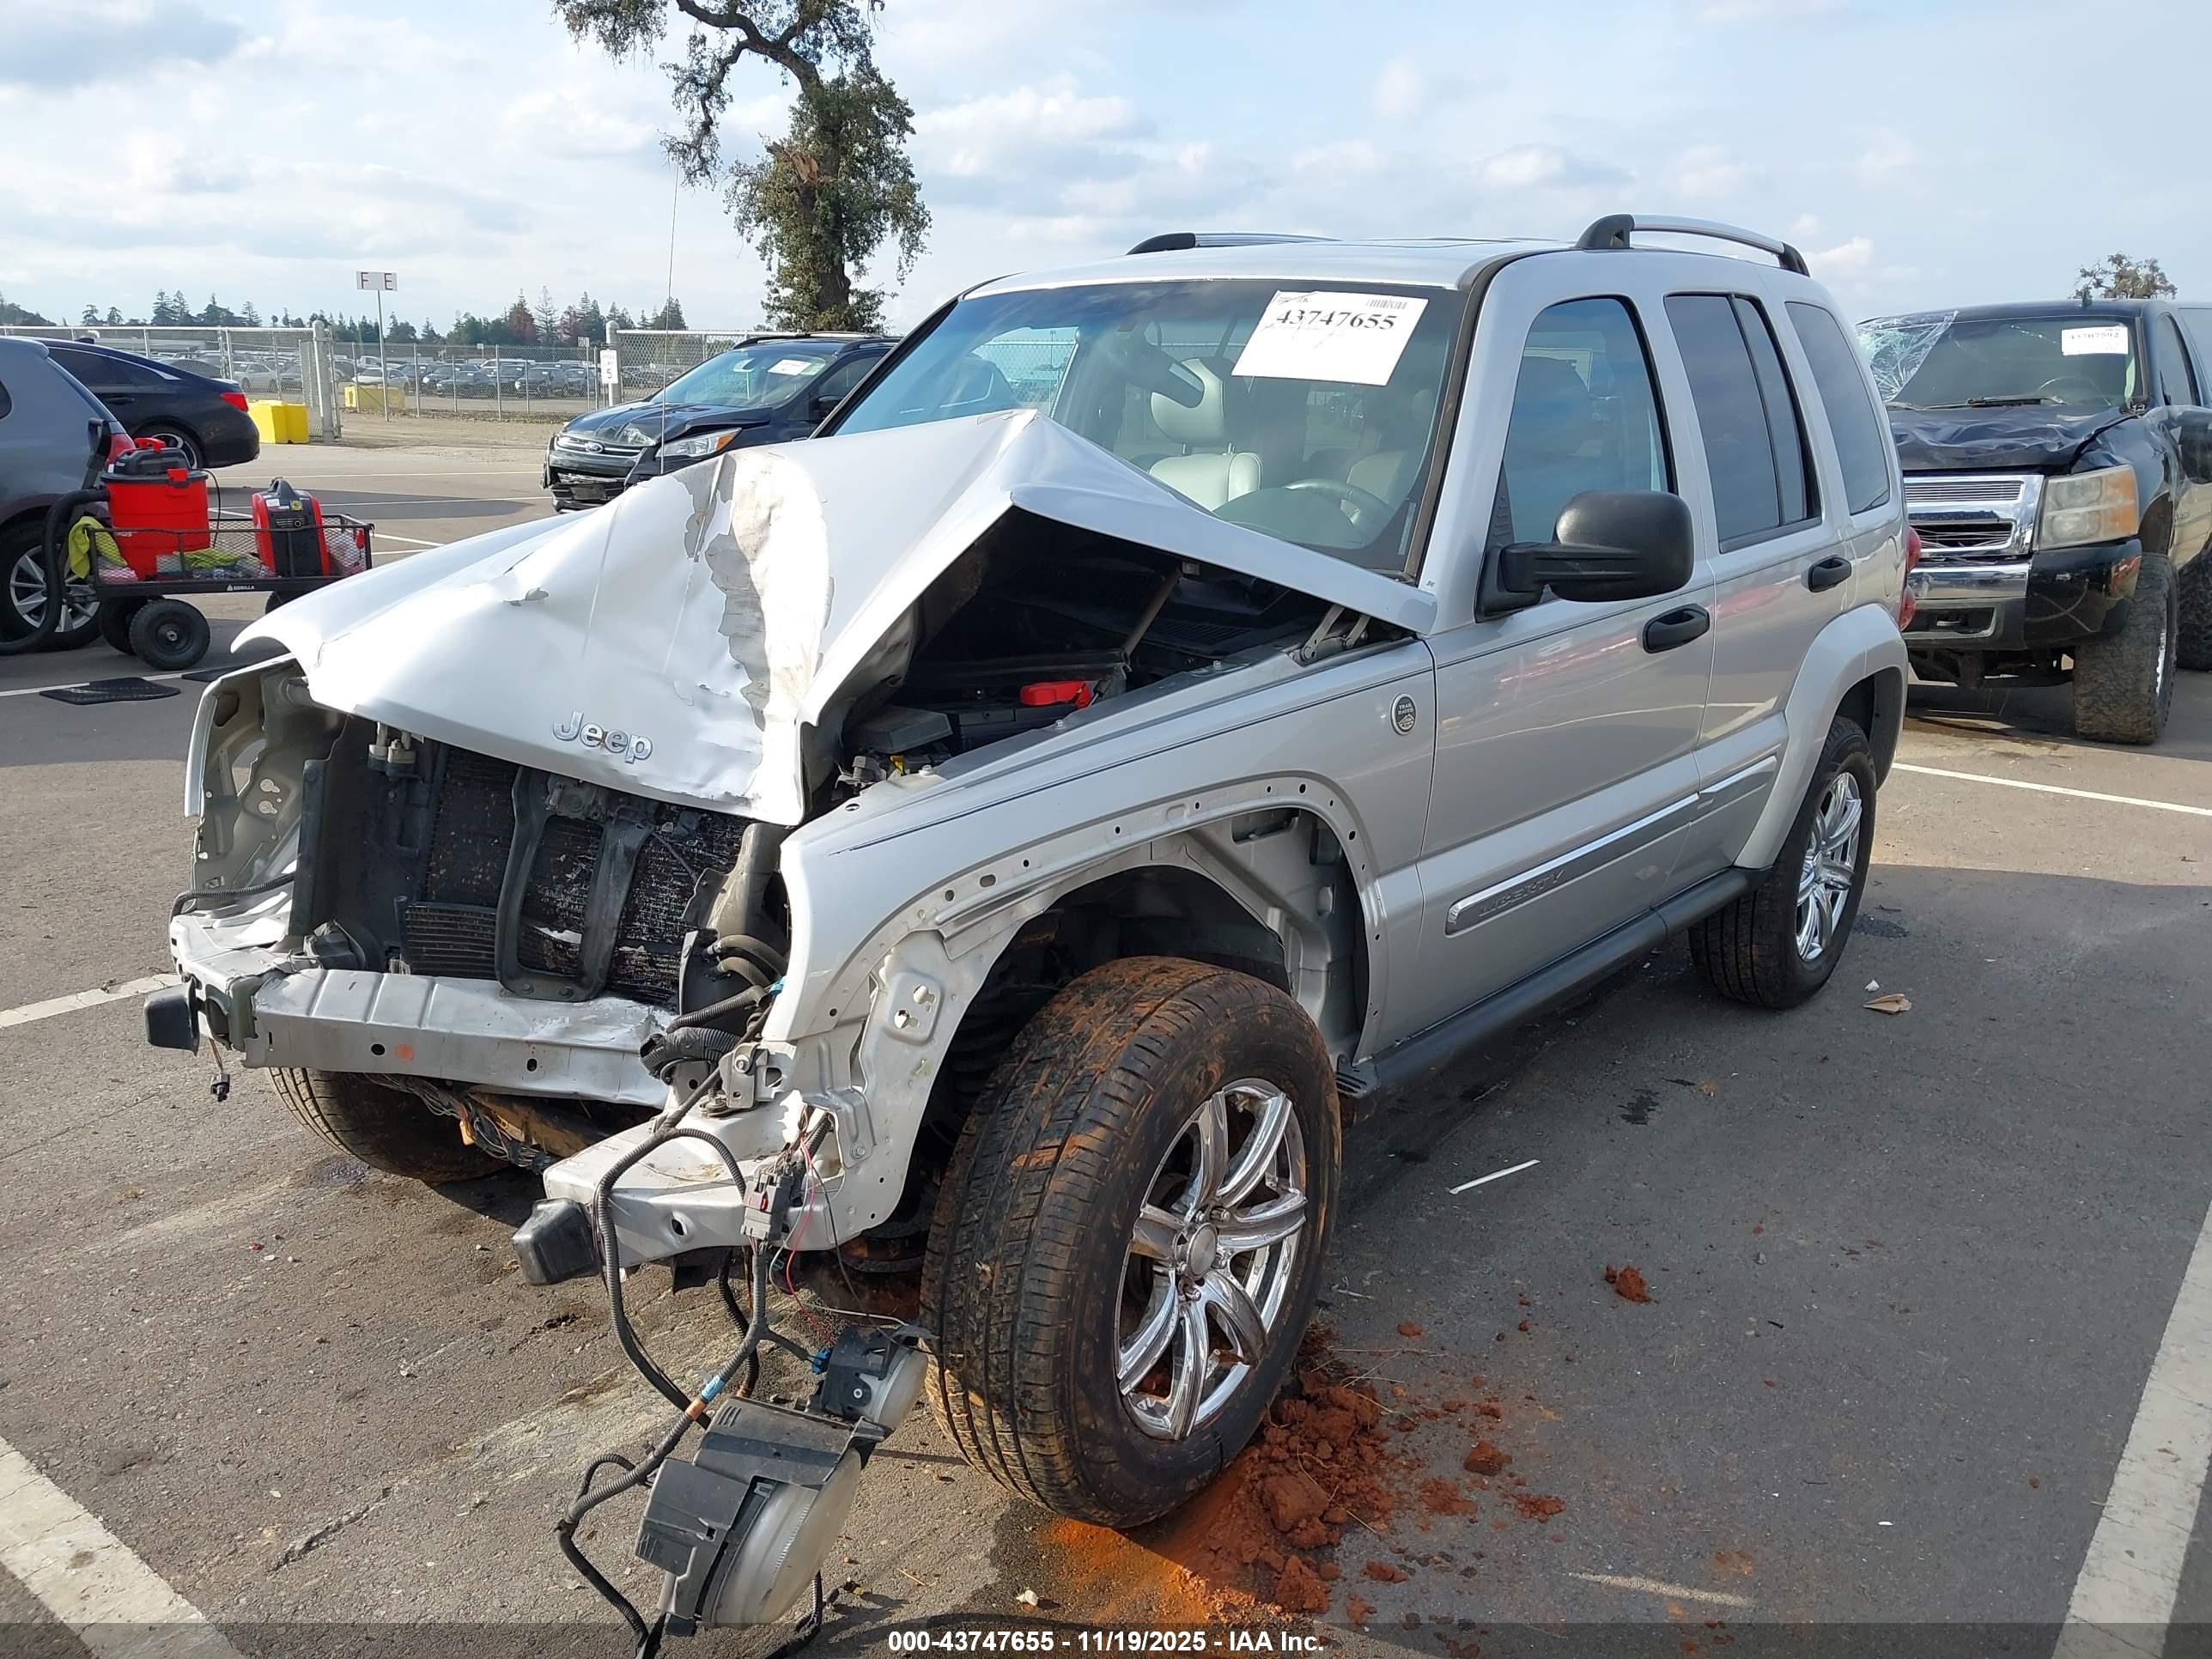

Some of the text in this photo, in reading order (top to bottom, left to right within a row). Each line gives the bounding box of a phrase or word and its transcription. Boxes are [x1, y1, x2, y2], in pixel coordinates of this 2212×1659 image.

[361, 271, 393, 290] F E
[1276, 309, 1398, 330] 43747655
[606, 368, 612, 380] 5
[552, 709, 653, 764] Jeep
[1479, 869, 1565, 917] LIBERTY
